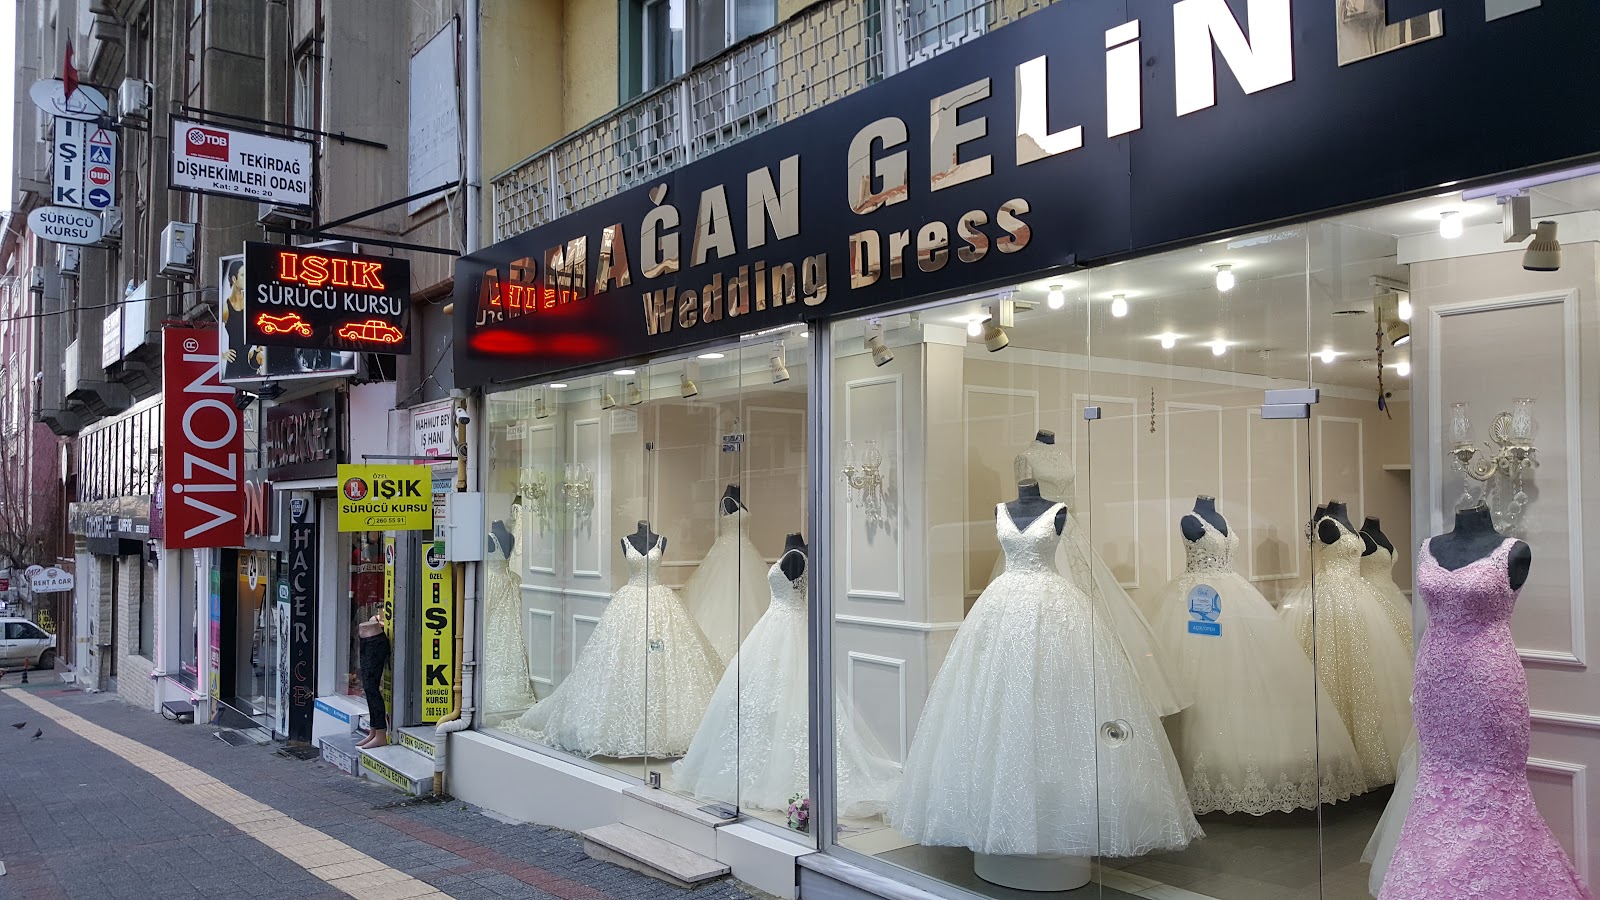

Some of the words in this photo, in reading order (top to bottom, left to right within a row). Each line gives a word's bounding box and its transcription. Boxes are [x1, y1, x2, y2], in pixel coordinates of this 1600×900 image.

[205, 134, 227, 147] TDB
[57, 121, 79, 204] IŞIK
[240, 153, 300, 175] TEKİRDAĞ
[90, 171, 110, 181] DUR
[177, 158, 266, 187] DİŞHEKİMLERİ
[270, 176, 307, 194] ODASI
[213, 182, 231, 191] Kat:
[244, 187, 259, 195] No:
[39, 212, 94, 228] SÜRÜCÜ
[45, 225, 88, 239] KURSU
[475, 153, 800, 329] ARMAĞAN
[280, 252, 385, 290] IŞIK
[642, 253, 829, 336] Wedding
[848, 198, 1032, 290] Dress
[257, 281, 337, 310] SÜRÜCÜ
[343, 292, 402, 316] KURSU
[415, 415, 439, 431] MAHMUT
[441, 413, 451, 427] BEY
[421, 430, 427, 449] İŞ
[373, 479, 422, 500] IŞIK
[342, 502, 388, 513] SÜRÜCÜ
[391, 504, 428, 513] KURSU
[33, 578, 50, 587] RENT
[58, 577, 72, 585] CAR
[292, 528, 309, 644] HACER
[425, 696, 448, 704] KURSU
[426, 687, 448, 695] SÜRÜCÜ
[425, 707, 435, 716] 260
[436, 707, 442, 716] 55
